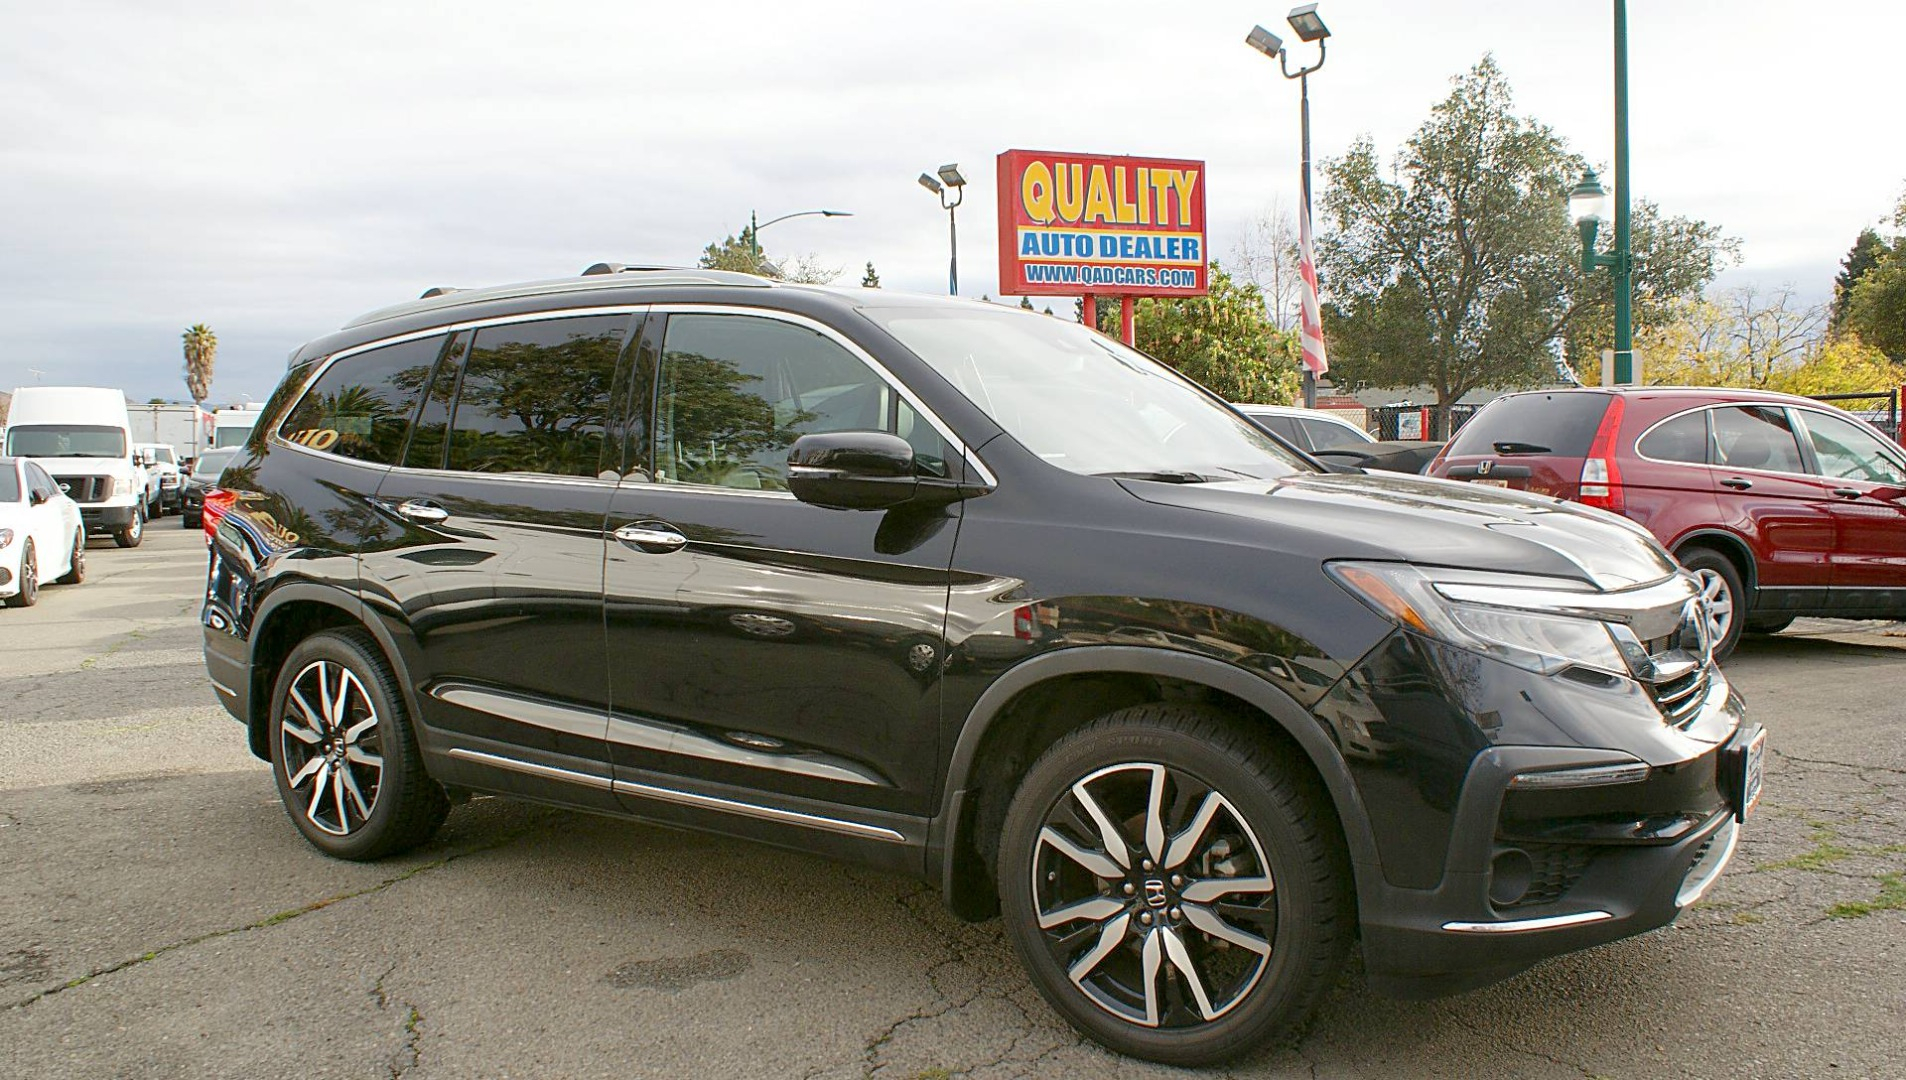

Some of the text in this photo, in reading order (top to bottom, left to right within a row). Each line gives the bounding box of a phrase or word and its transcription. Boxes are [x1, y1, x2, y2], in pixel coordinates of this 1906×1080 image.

[1022, 160, 1198, 226] QUALITY
[1021, 232, 1199, 260] AUTO DEALER
[1025, 264, 1196, 287] WWW.QADCARS.COM
